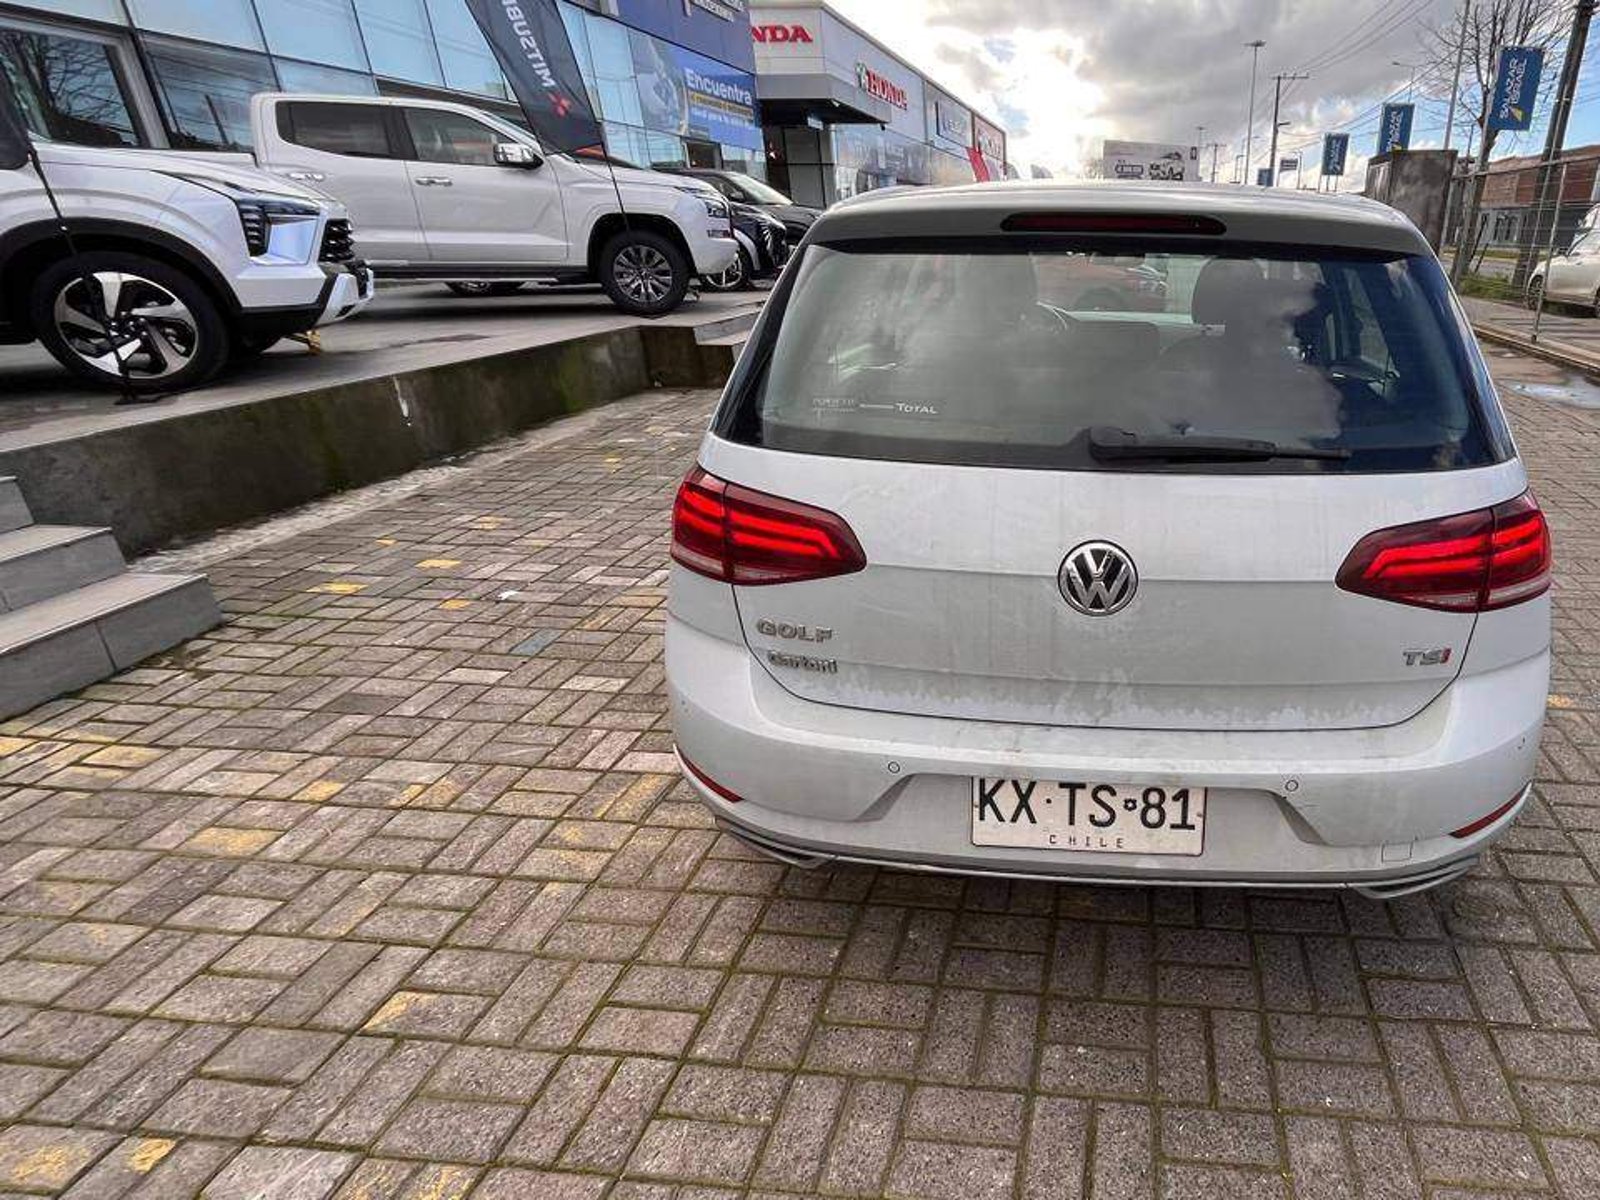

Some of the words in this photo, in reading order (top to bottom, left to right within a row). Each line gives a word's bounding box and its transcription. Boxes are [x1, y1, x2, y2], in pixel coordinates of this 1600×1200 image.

[684, 66, 752, 107] Encuentra
[757, 618, 833, 643] GOLF
[1049, 834, 1125, 849] CHILE
